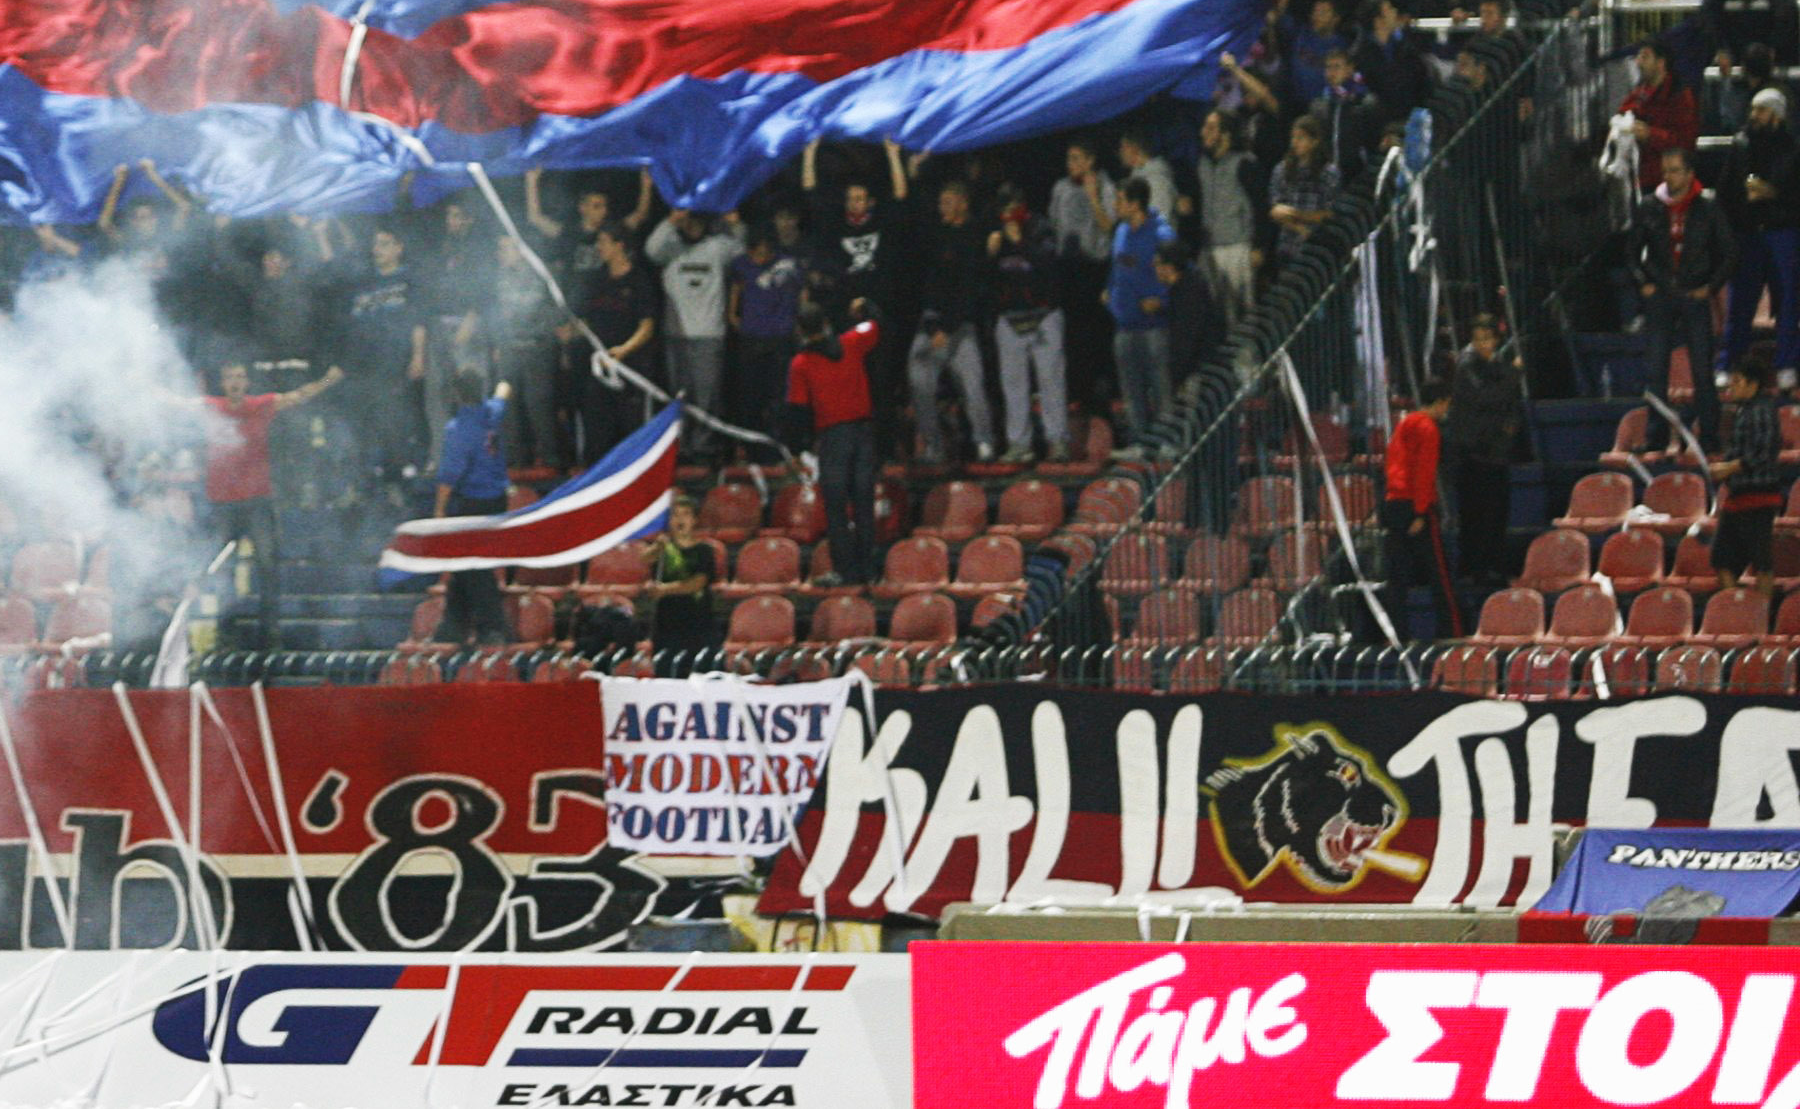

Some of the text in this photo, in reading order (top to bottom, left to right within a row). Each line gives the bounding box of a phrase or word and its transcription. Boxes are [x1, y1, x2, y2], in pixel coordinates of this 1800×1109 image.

[608, 701, 832, 743] AGAINST
[605, 753, 824, 795] MODERN
[1607, 844, 1800, 872] PANTHERS
[525, 1006, 820, 1034] RADIAL
[1002, 951, 1800, 1109] Πάμε ΣΤΟΙ
[496, 1084, 797, 1107] ΕΛΑΣΤΙΚΑ
